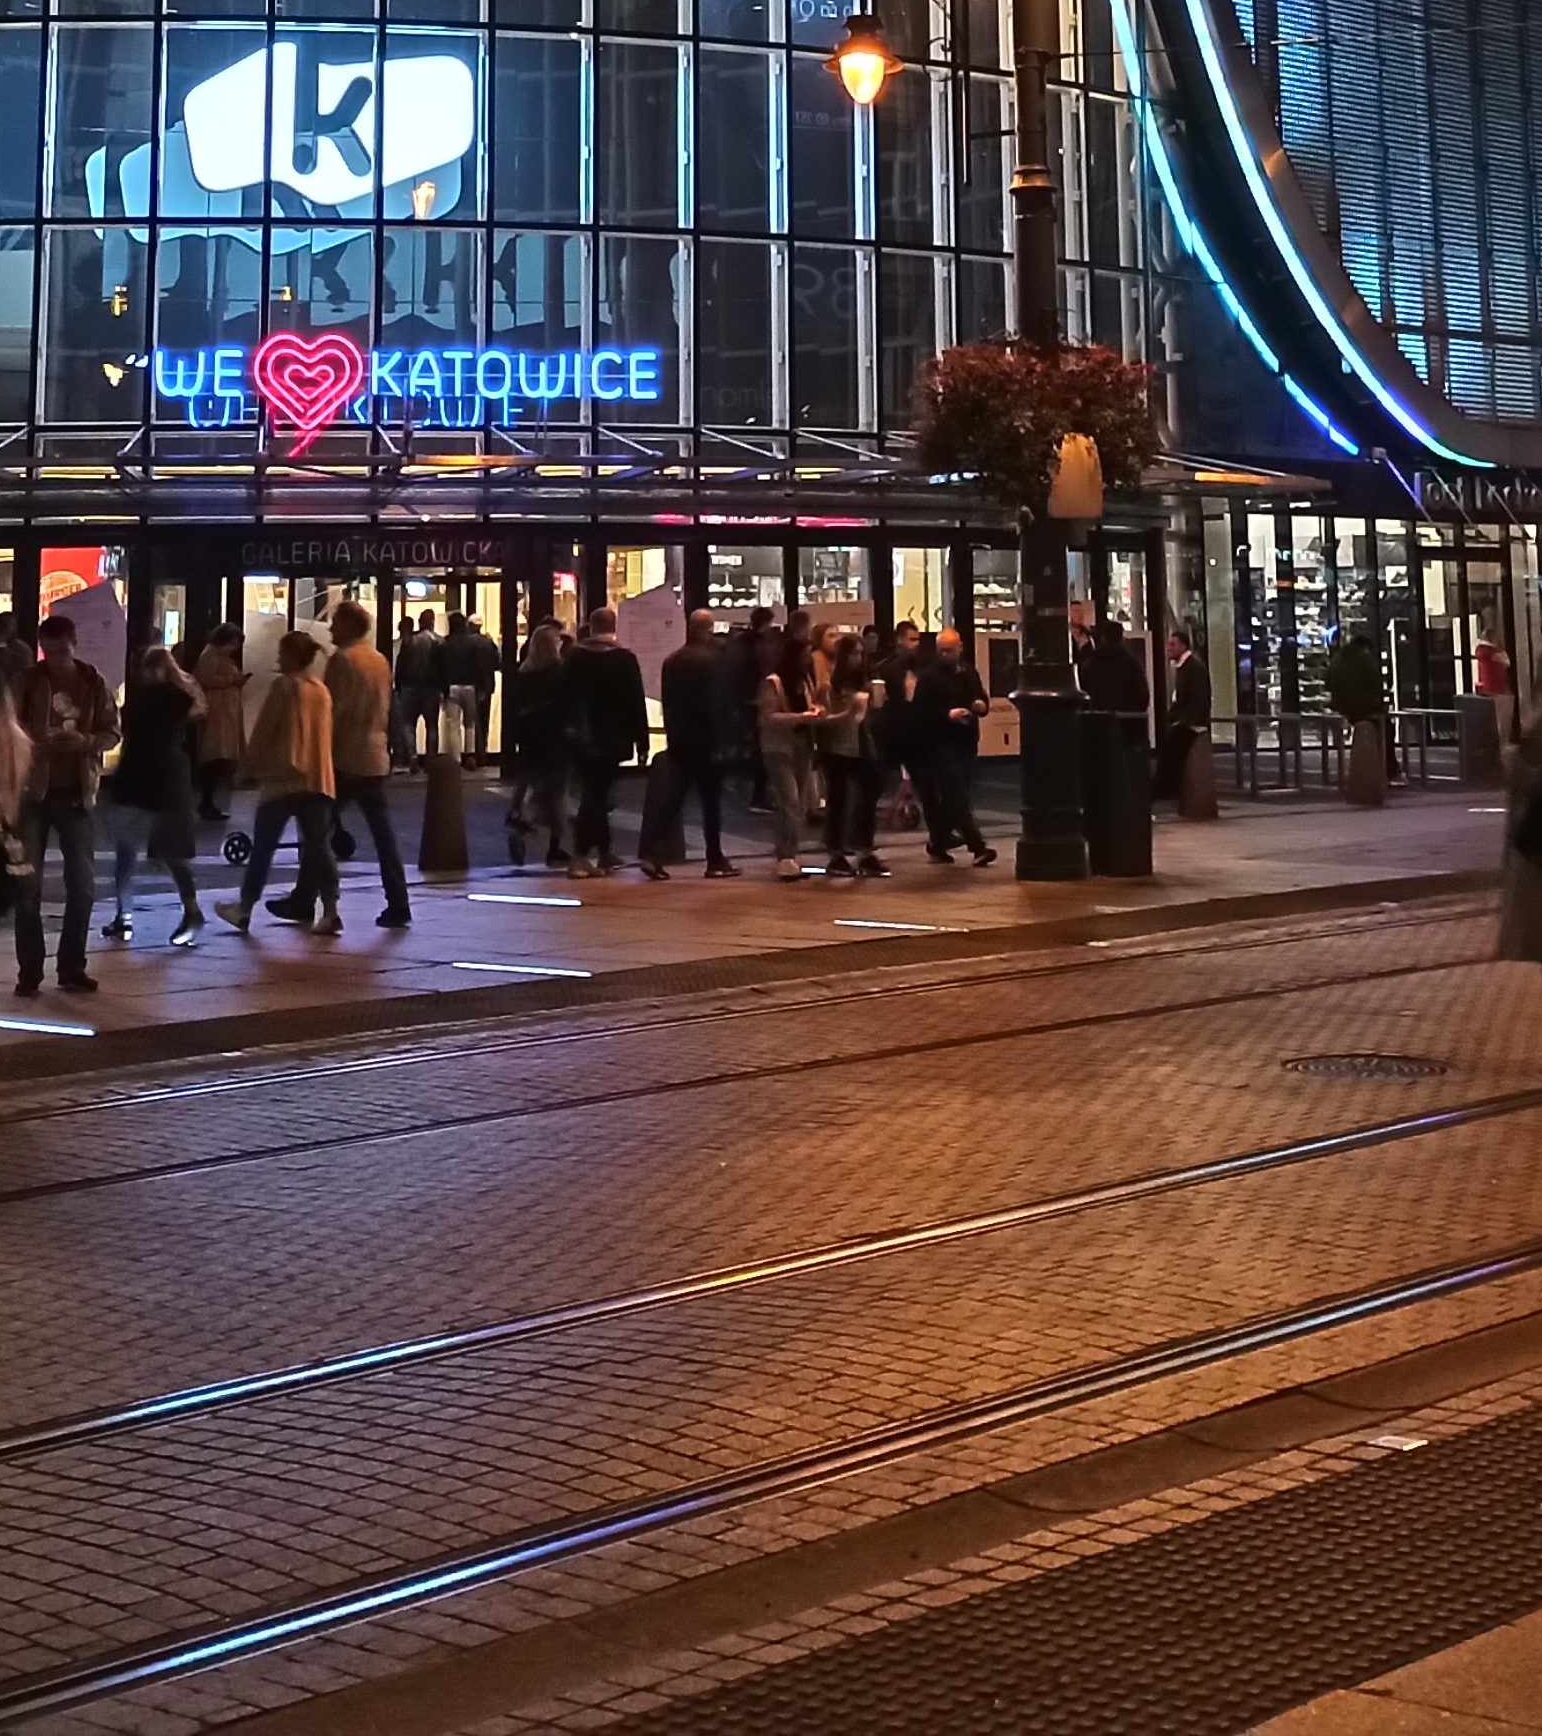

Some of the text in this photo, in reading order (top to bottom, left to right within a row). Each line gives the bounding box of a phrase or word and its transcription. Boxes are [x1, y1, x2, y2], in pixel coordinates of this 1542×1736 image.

[155, 348, 245, 400] WE
[369, 349, 658, 401] KATOWICE
[241, 540, 508, 564] GALERIA KATOWICKA
